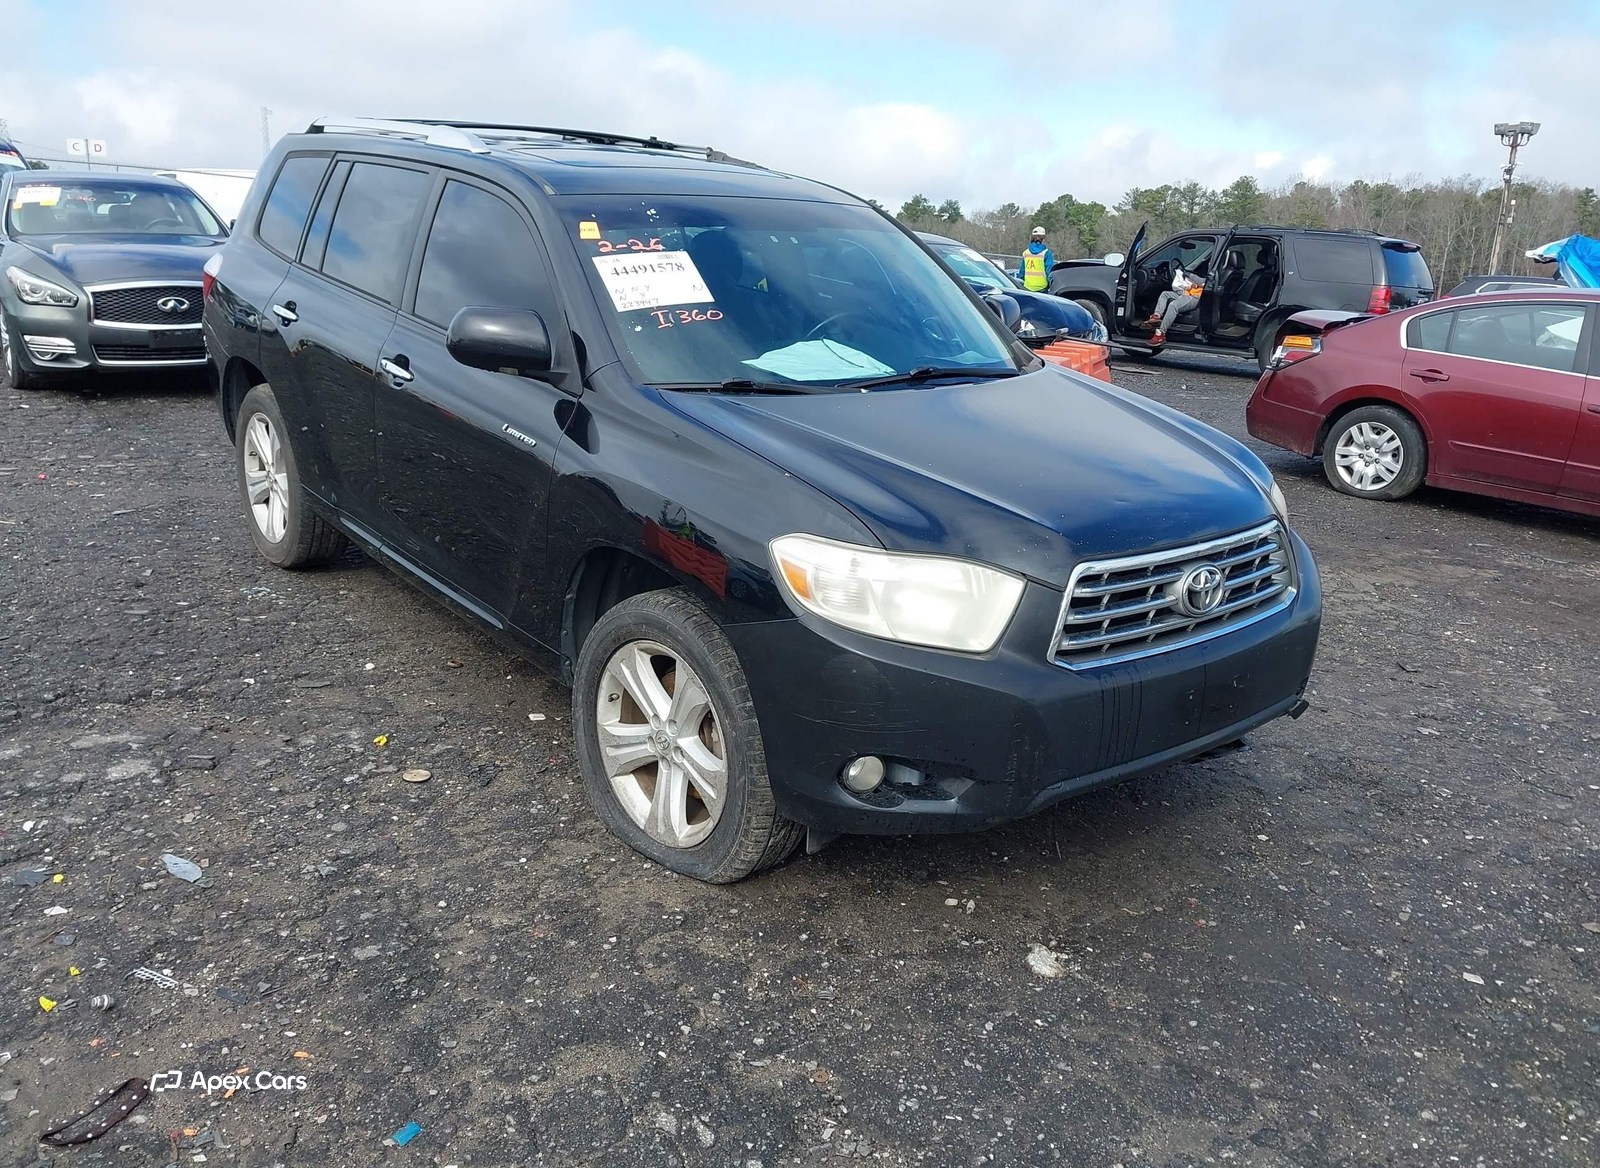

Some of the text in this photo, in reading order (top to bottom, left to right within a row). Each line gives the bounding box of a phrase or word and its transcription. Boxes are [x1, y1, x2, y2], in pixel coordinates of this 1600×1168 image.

[72, 142, 80, 151] C
[94, 143, 102, 153] D
[611, 262, 686, 276] 44491578
